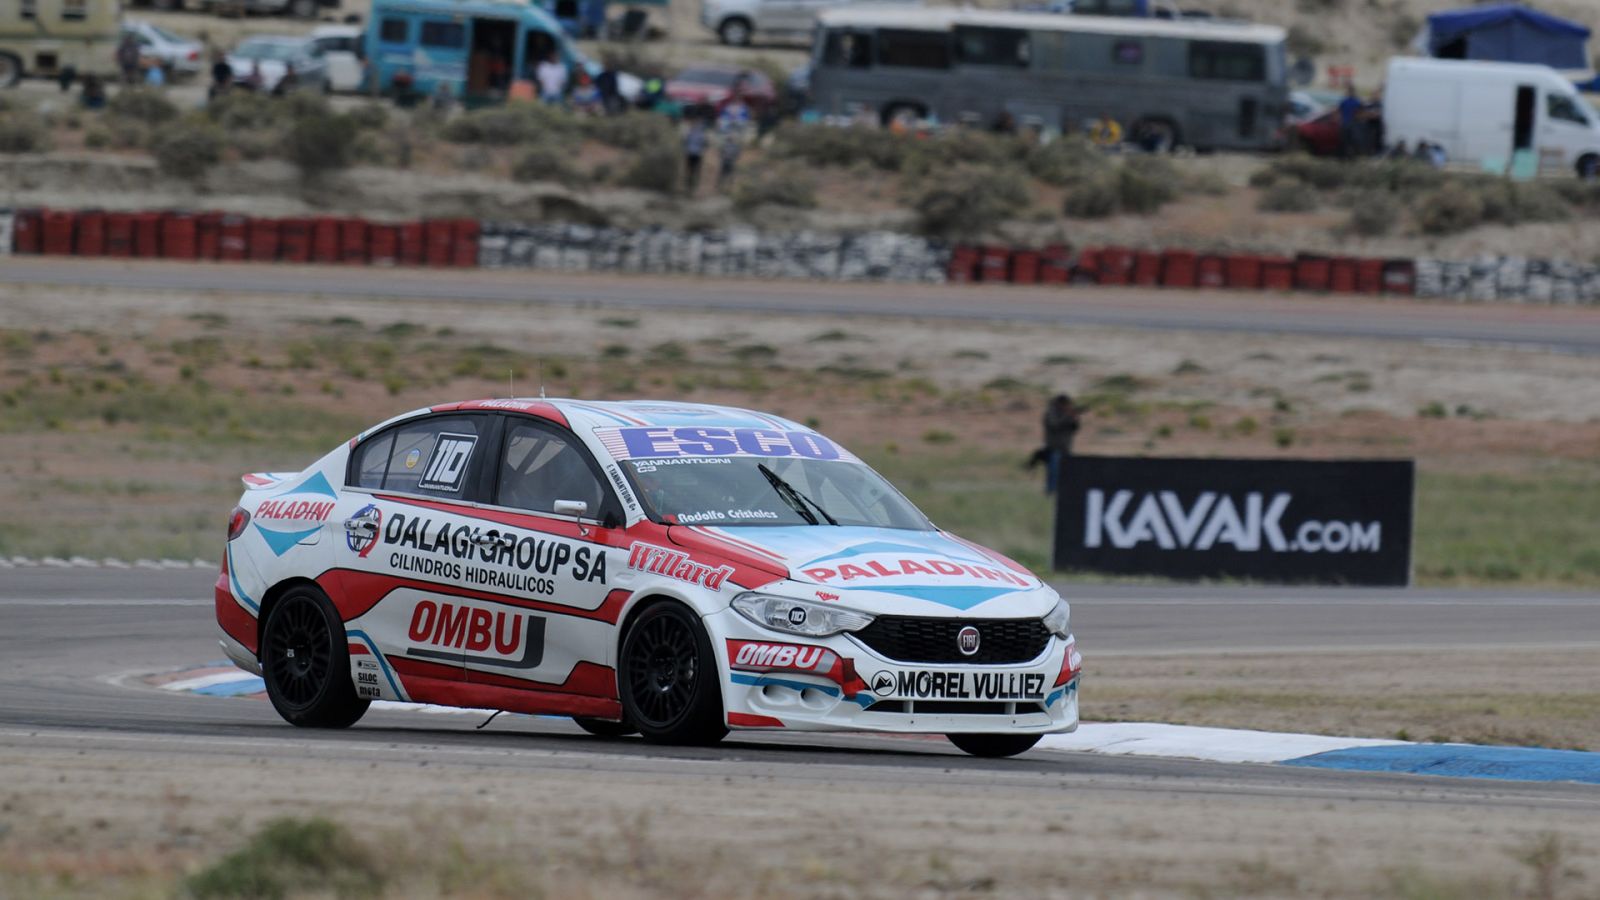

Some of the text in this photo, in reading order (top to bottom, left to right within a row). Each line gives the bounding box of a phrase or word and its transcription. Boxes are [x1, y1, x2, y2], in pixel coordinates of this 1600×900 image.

[619, 427, 840, 461] ESCO
[425, 439, 474, 484] 110
[632, 458, 731, 467] YANNANTUONI
[253, 500, 336, 521] PALADINI
[677, 509, 778, 523] Rodolfo Cristales
[1084, 489, 1382, 553] KAVAK.COM
[390, 552, 555, 595] CILINDROS HIDRAULICOS
[628, 542, 733, 592] Willard
[802, 559, 1030, 587] PALADINI
[408, 600, 523, 655] OMBU
[790, 610, 805, 622] 110
[962, 634, 977, 648] FIAT
[736, 643, 823, 669] OMBU
[358, 672, 378, 683] SILOC
[898, 671, 1045, 699] MOREL VULLIEZ
